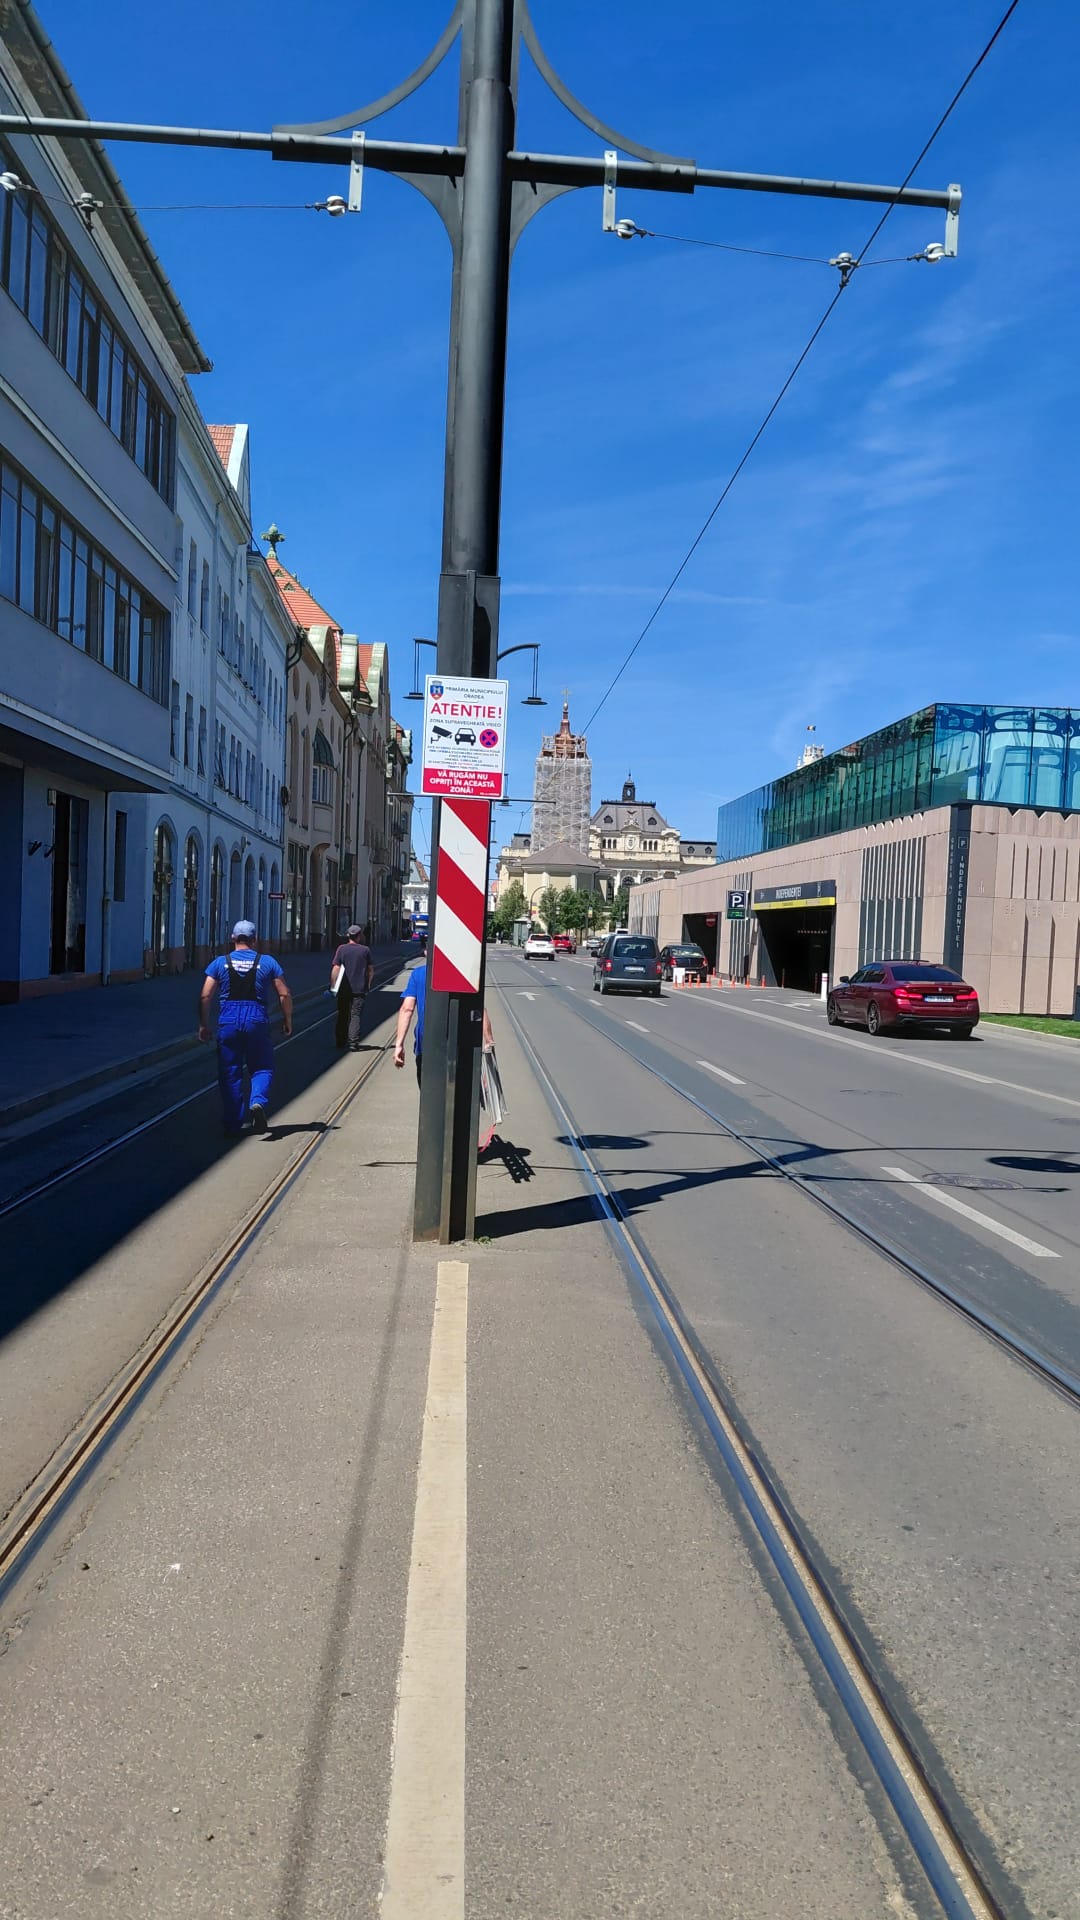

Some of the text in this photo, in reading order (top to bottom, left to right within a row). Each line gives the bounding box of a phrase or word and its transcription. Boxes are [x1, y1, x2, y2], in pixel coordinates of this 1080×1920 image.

[437, 769, 448, 777] VĂ
[448, 770, 476, 780] RUGĂM
[454, 777, 462, 785] ÎN
[463, 779, 495, 788] ACEASTĂ
[450, 785, 474, 793] ZONĂ!
[732, 895, 742, 908] P
